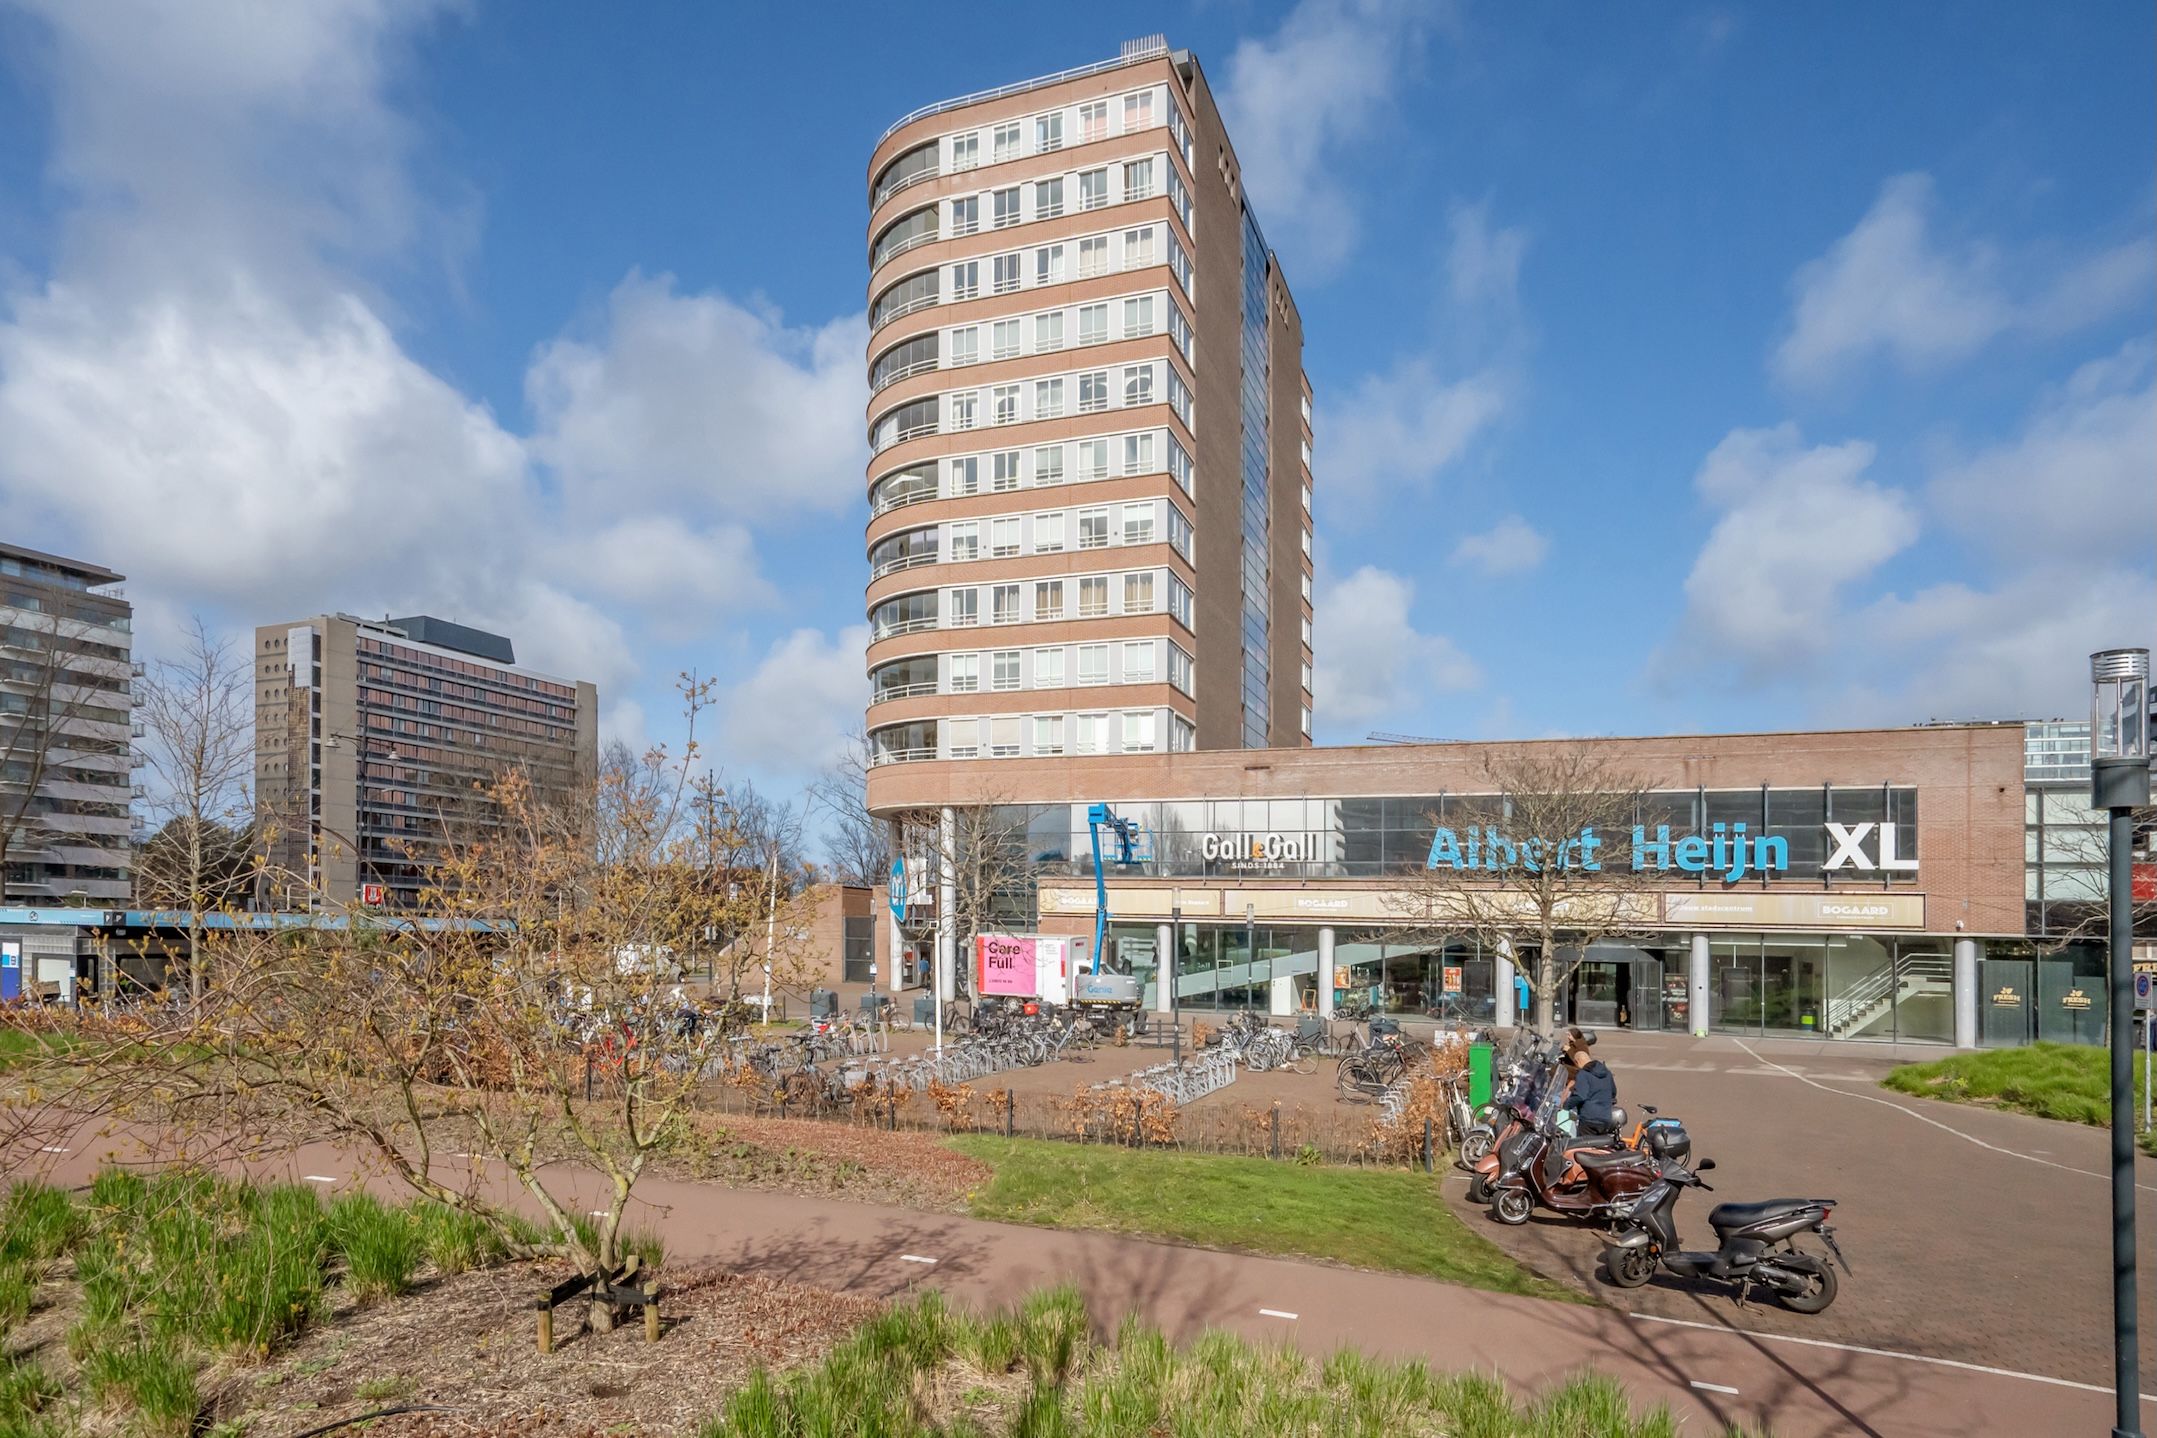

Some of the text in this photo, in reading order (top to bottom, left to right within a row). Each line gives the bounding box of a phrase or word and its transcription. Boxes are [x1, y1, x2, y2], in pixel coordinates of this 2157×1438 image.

[1632, 822, 1788, 883] Heijn
[1822, 822, 1919, 870] XL
[1822, 905, 1888, 915] BOGAARD
[988, 941, 1020, 955] Care
